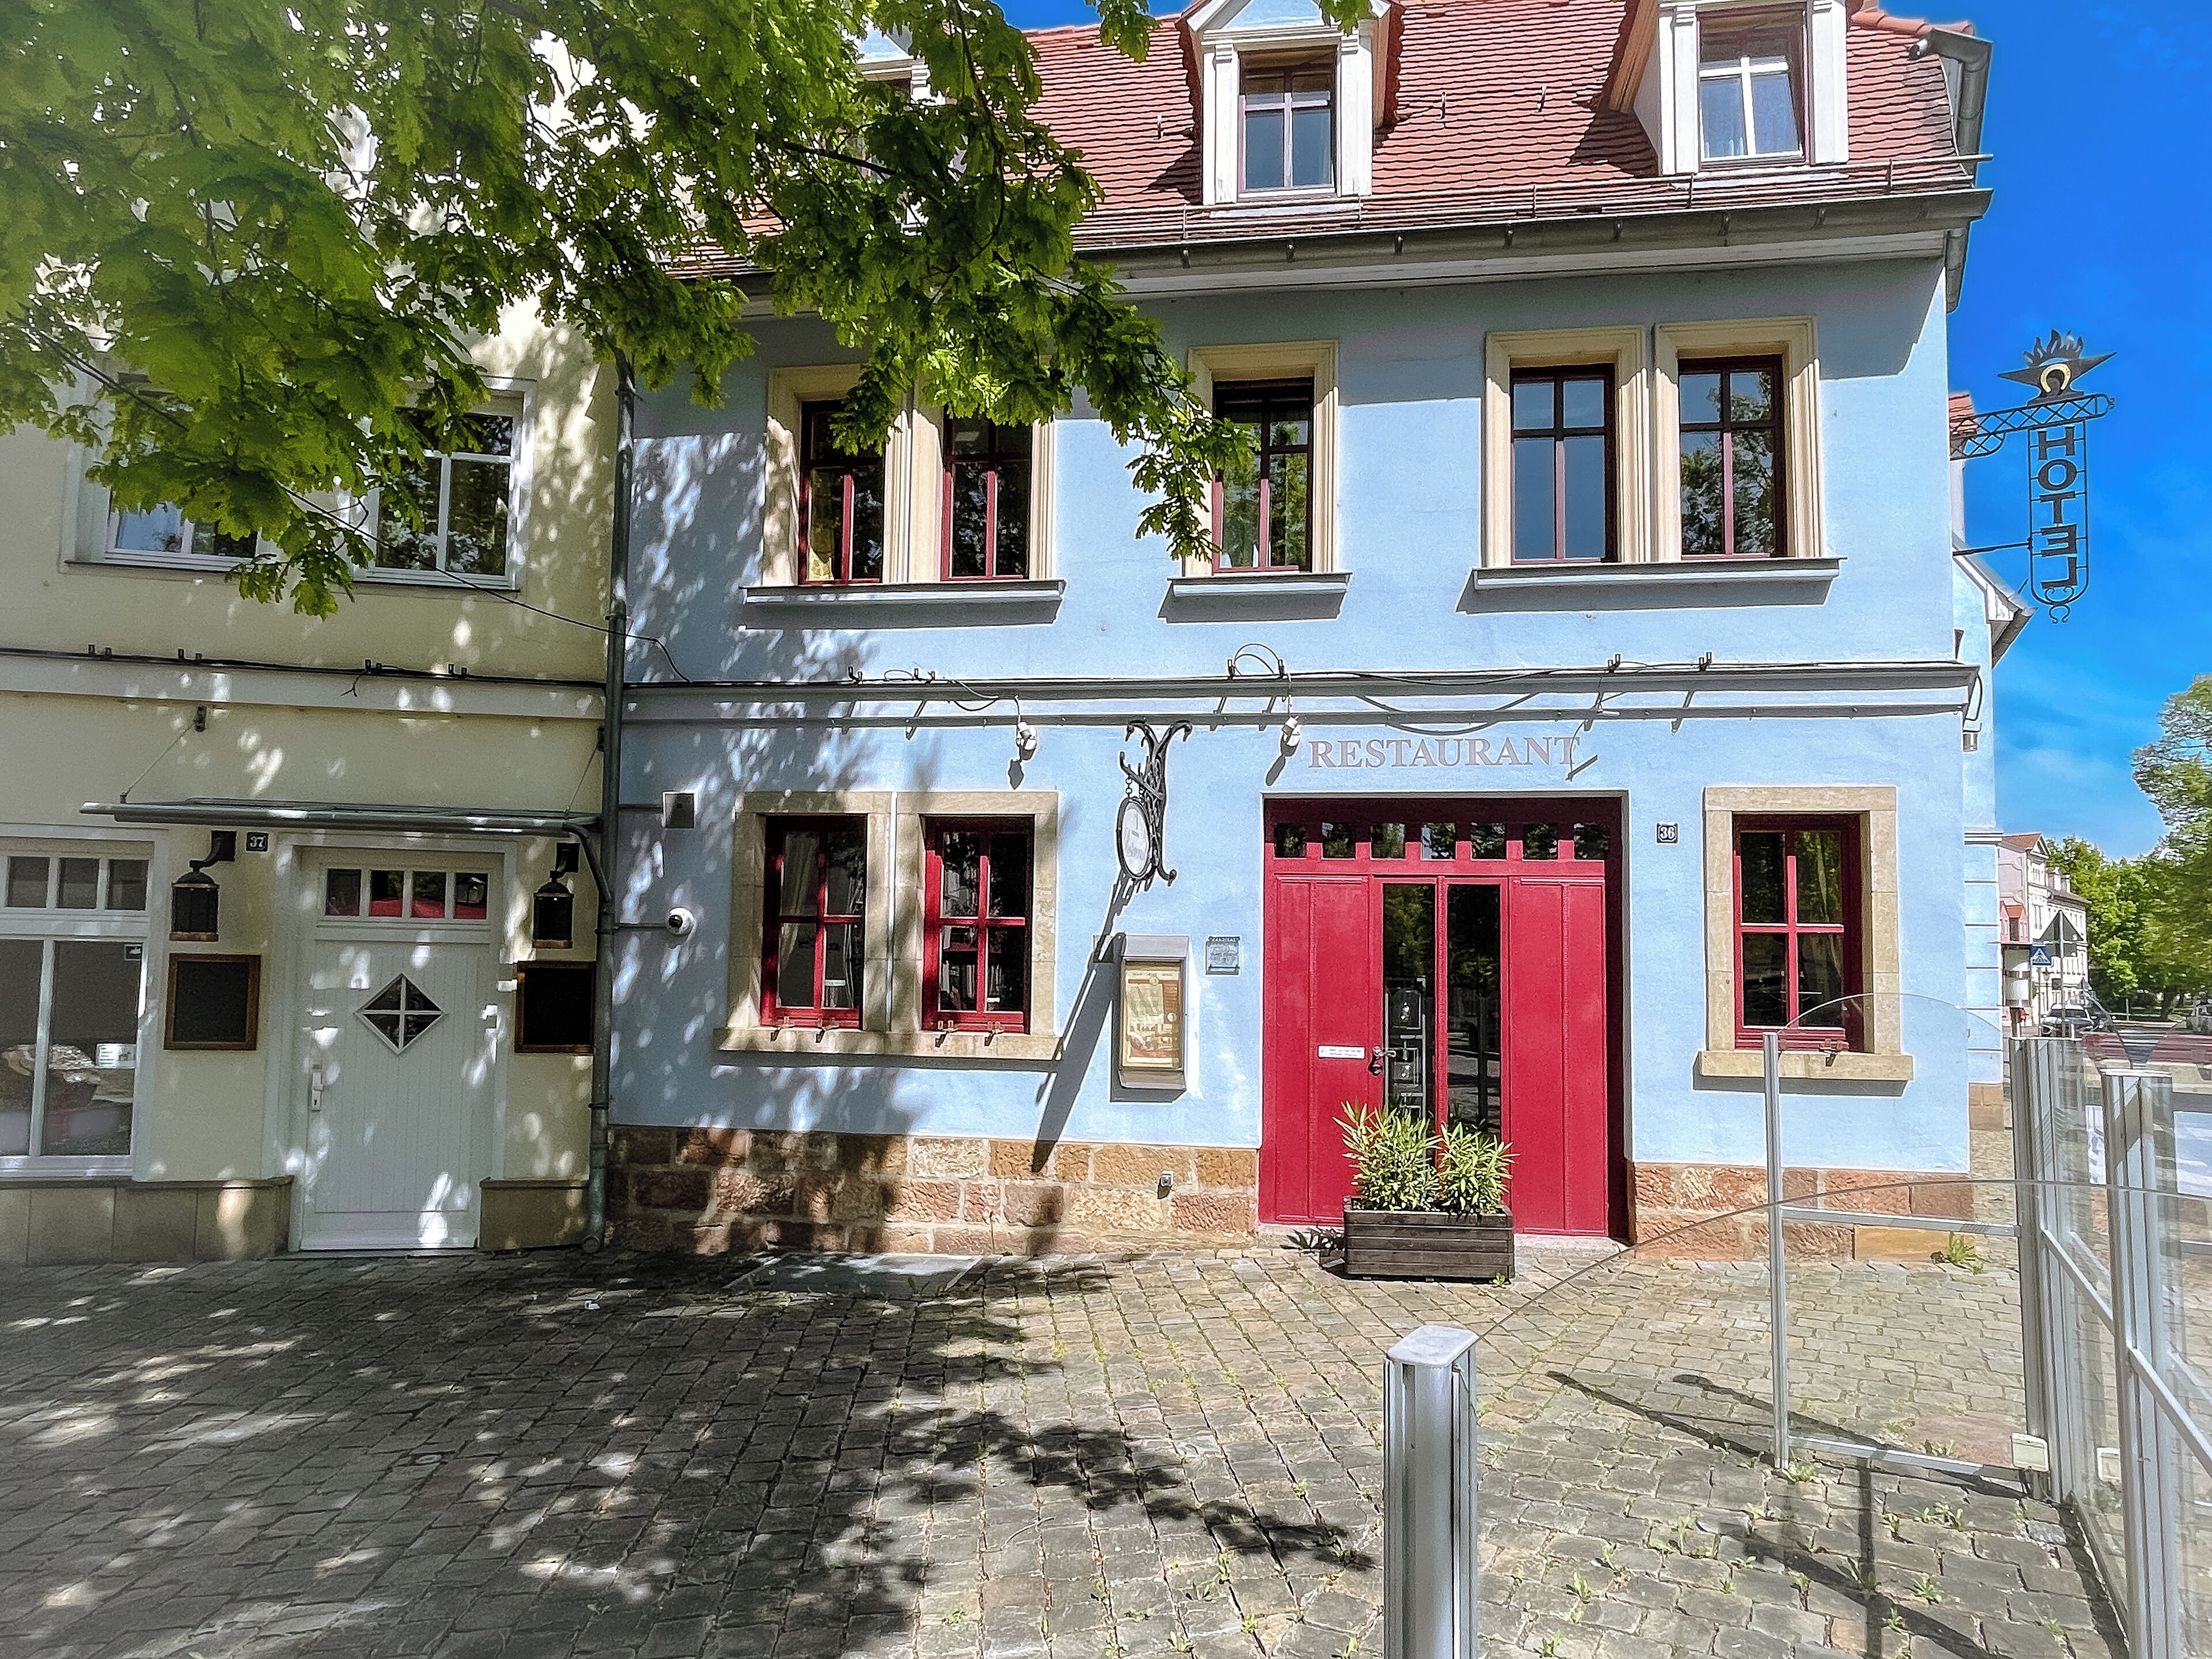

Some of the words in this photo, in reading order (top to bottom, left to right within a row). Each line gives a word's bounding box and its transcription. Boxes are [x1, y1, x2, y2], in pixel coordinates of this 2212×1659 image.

[1308, 736, 1581, 770] RESTAURANT
[1660, 826, 1675, 839] 36
[249, 836, 264, 847] 37
